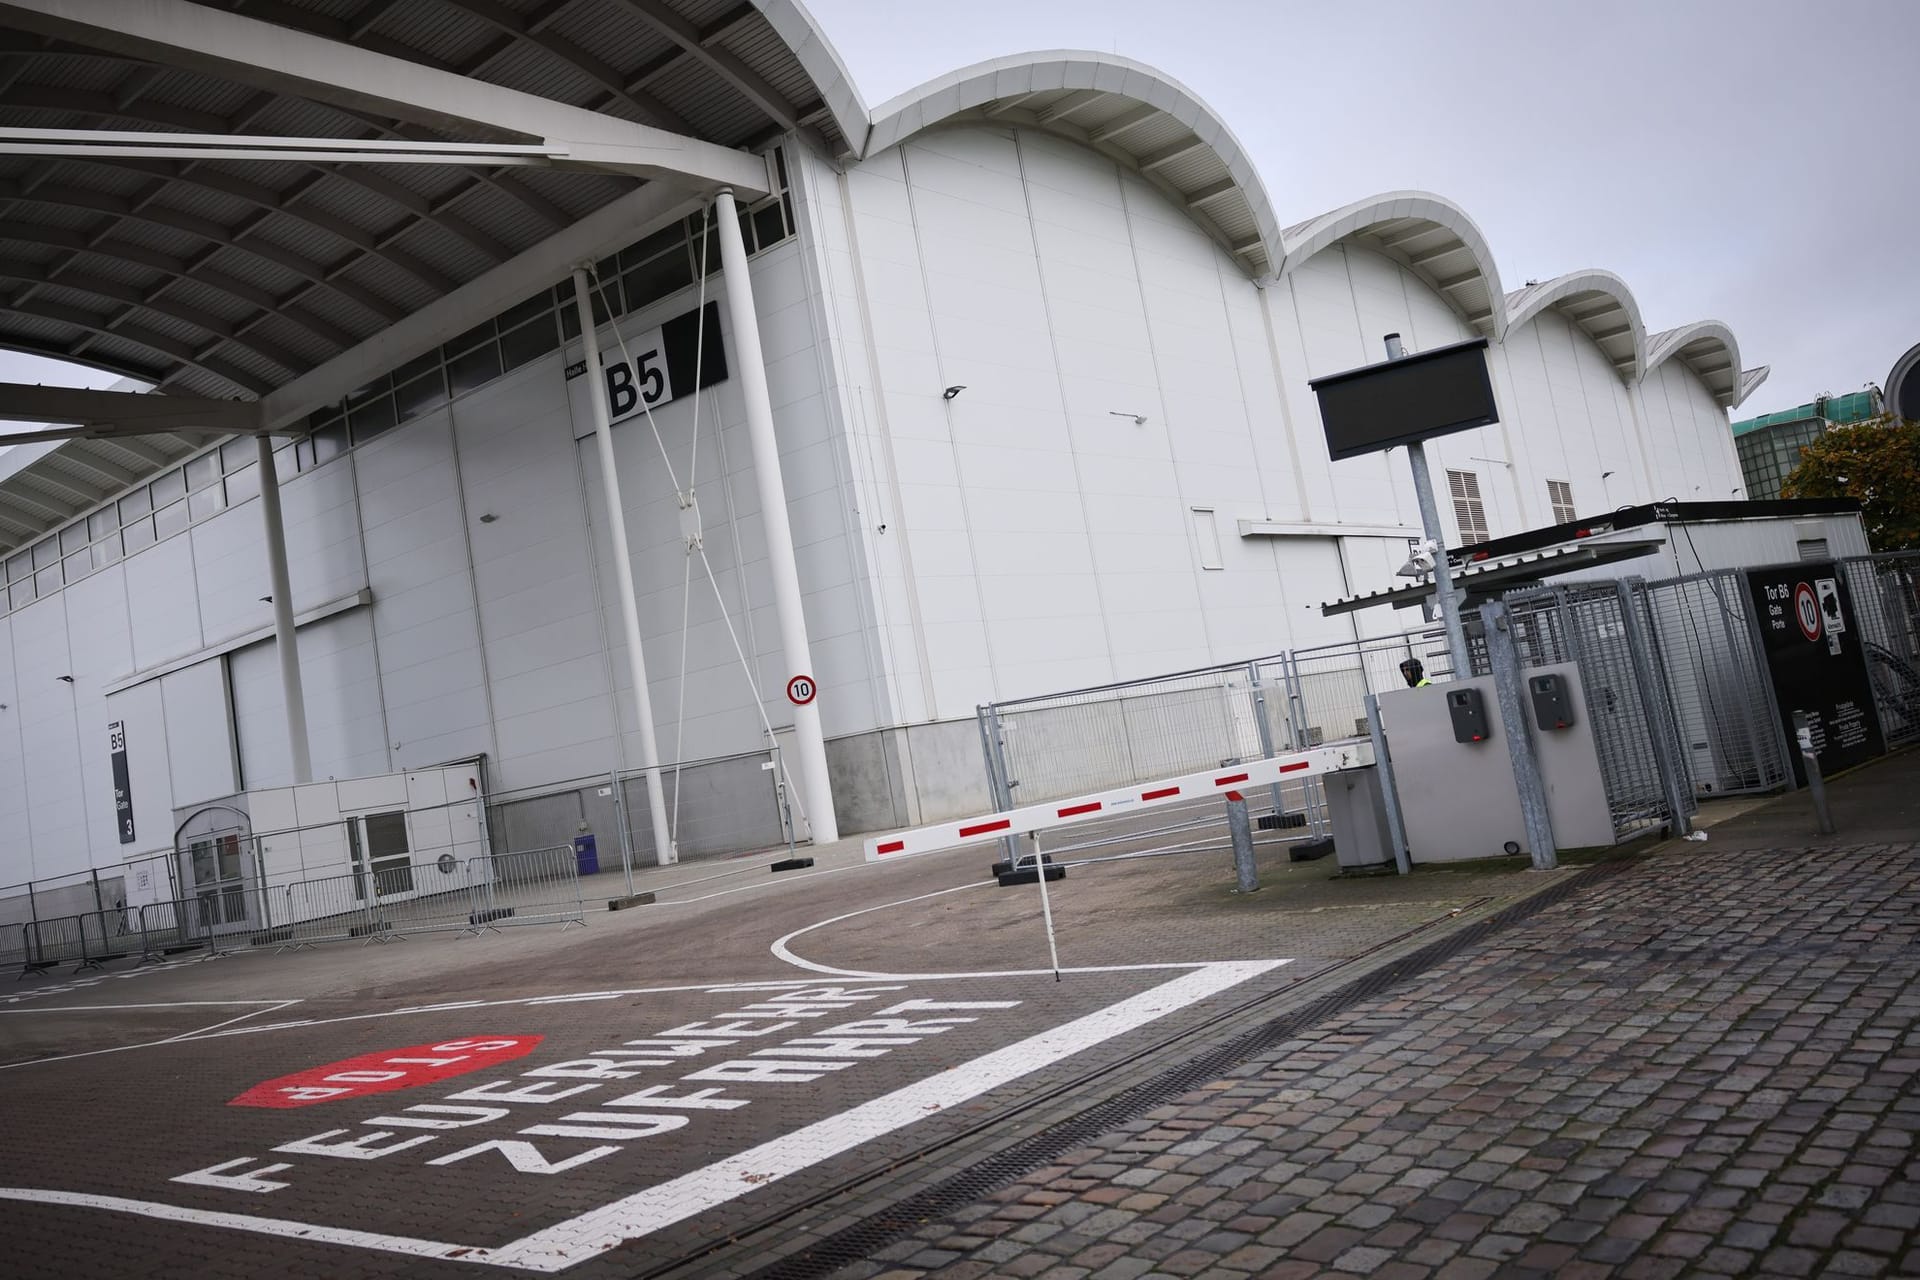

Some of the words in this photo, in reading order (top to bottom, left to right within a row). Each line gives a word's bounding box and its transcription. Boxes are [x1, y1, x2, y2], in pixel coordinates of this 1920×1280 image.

[606, 349, 664, 418] B5
[1764, 585, 1778, 600] Tor
[1778, 584, 1790, 599] B6
[1769, 604, 1783, 616] Gate
[1801, 600, 1815, 626] 10
[794, 683, 810, 698] 10
[111, 732, 123, 750] B5
[115, 789, 124, 798] Tor
[117, 800, 128, 810] Gate
[126, 819, 133, 835] 3
[277, 1038, 519, 1101] STOP
[168, 985, 909, 1194] FEUERWEHR
[425, 998, 1023, 1175] ZUFAHRT
